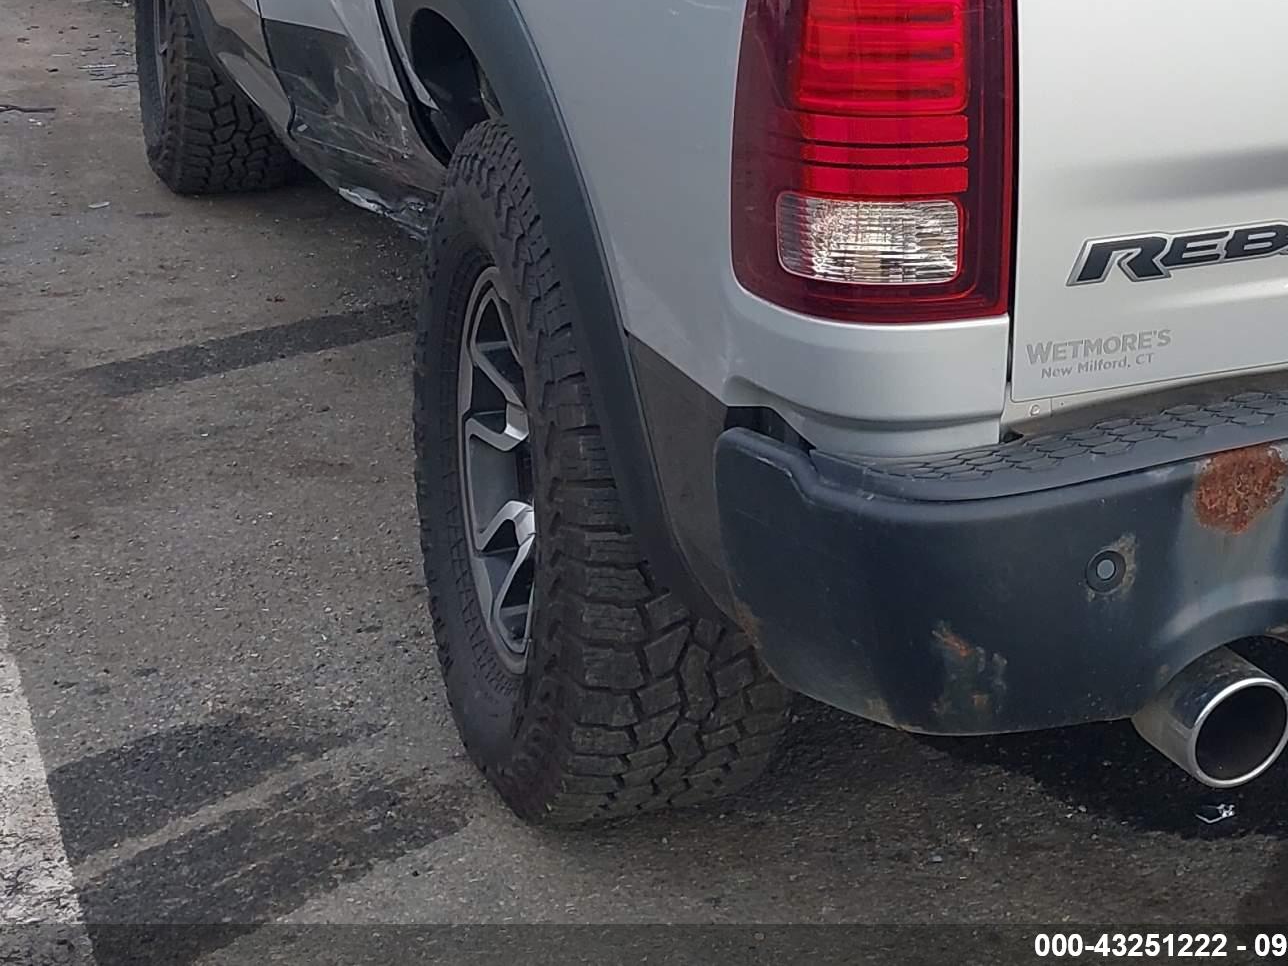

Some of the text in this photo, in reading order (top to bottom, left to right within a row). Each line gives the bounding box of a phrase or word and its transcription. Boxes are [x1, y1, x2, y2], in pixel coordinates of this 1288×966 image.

[1026, 329, 1172, 365] WETMORE'S
[1041, 352, 1156, 379] New Milford, CT
